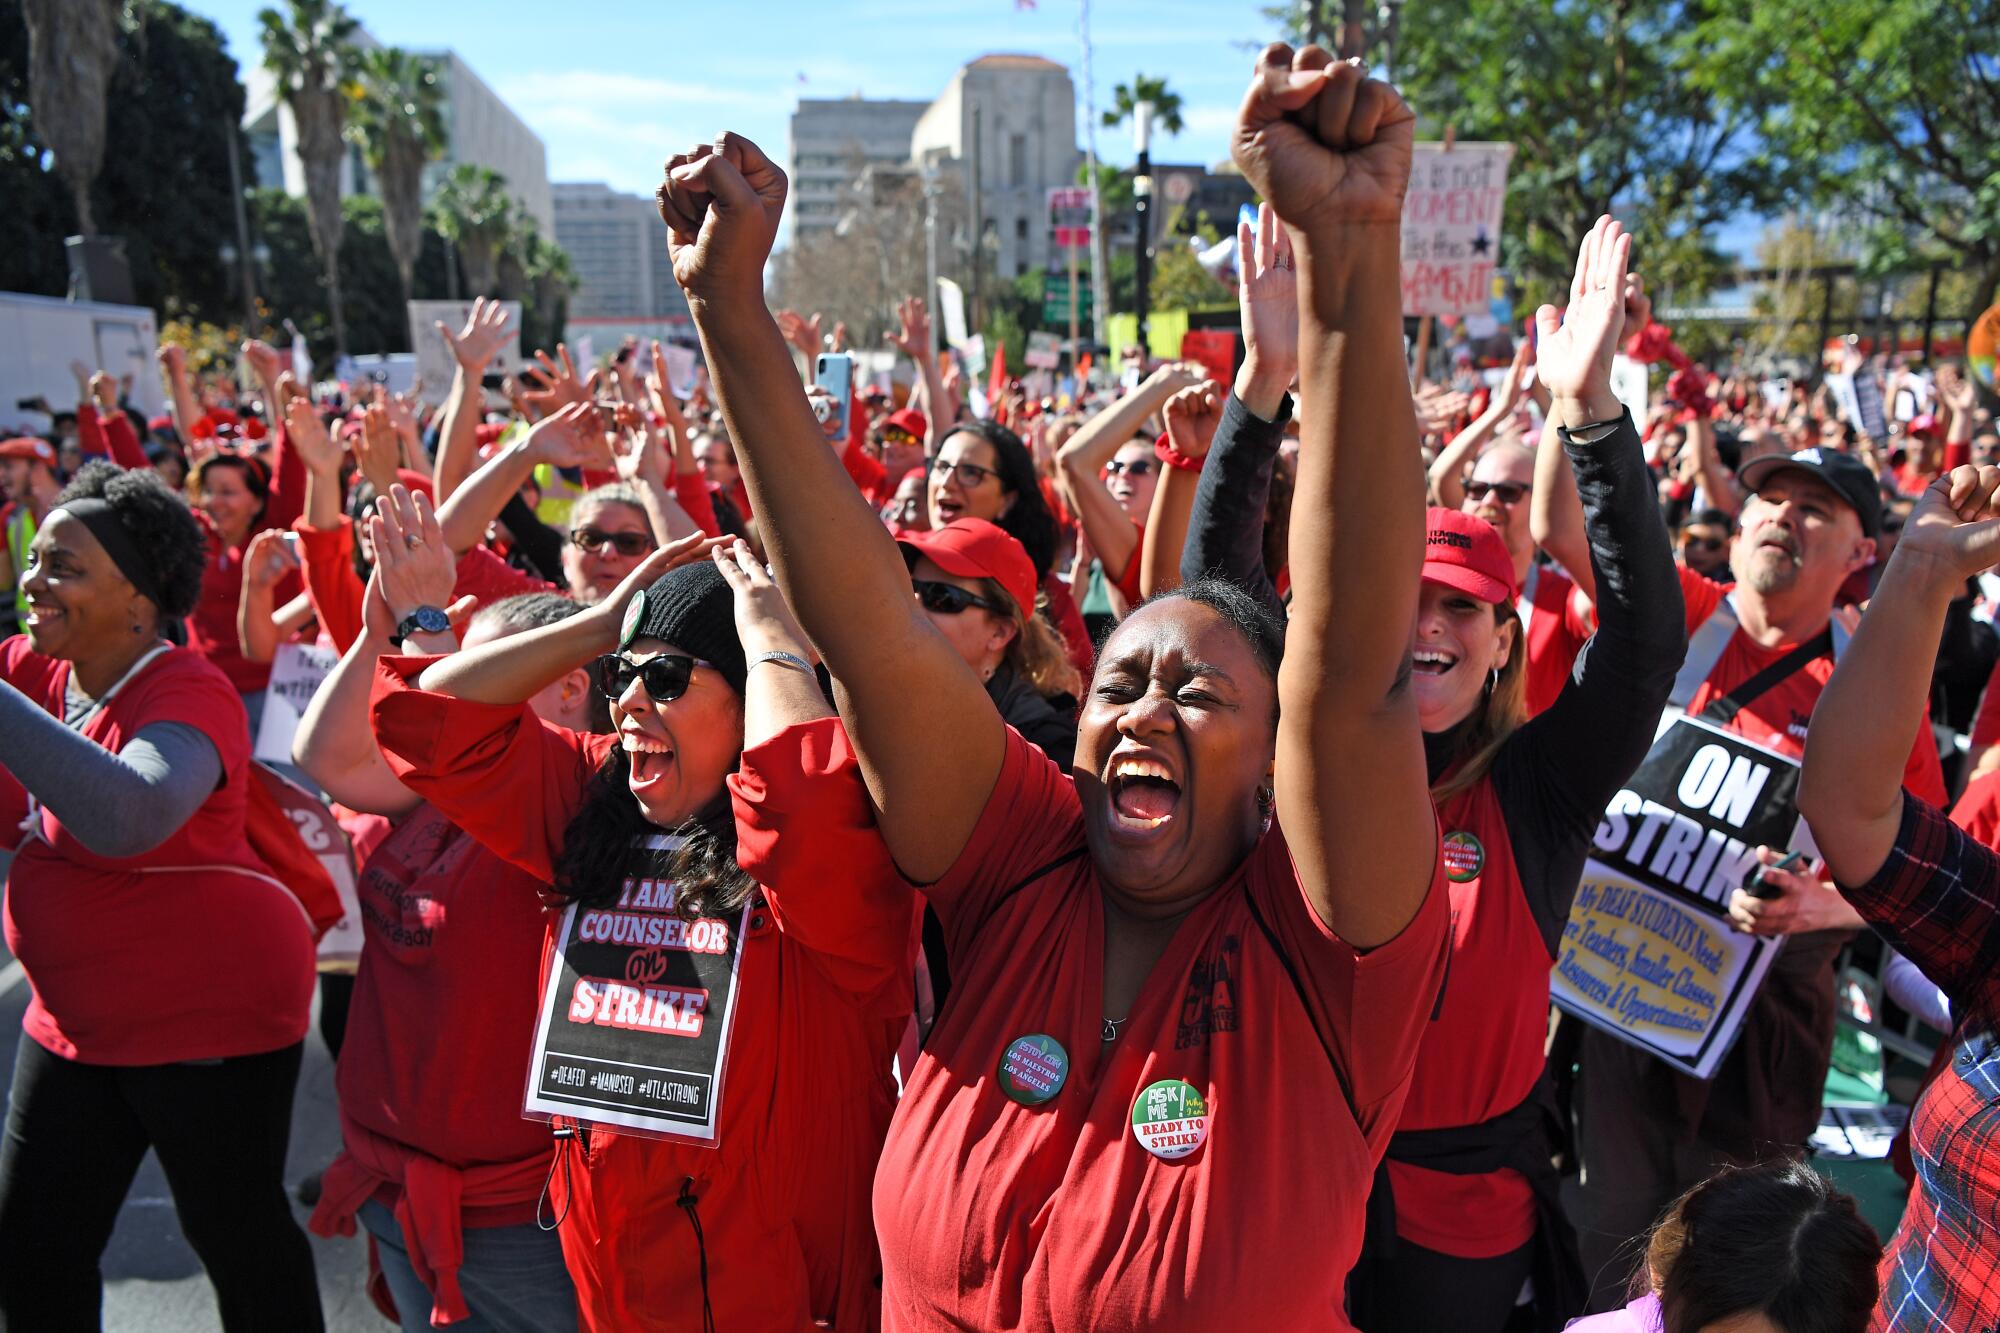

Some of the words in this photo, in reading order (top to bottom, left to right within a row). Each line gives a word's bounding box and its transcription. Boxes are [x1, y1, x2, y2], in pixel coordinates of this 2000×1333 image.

[1677, 744, 1770, 828] ON
[1593, 789, 1760, 908] STRIK
[619, 880, 634, 907] I
[633, 881, 676, 909] AM
[579, 914, 728, 952] COUNSELOR
[1595, 886, 1637, 918] DEAF
[1629, 893, 1697, 952] STUDENTS
[628, 950, 664, 980] on
[1558, 948, 1612, 1003] Resources
[1628, 941, 1675, 989] Smaller
[571, 982, 705, 1032] STRIKE
[1007, 1050, 1022, 1061] LOS
[1021, 1057, 1061, 1082] MAESTROS
[1018, 1041, 1045, 1059] ESTOY
[1043, 1054, 1063, 1069] CON
[550, 1066, 586, 1088] #DEAFED
[638, 1081, 700, 1105] #UTLASTRONG
[1003, 1063, 1018, 1075] LOS
[1017, 1072, 1051, 1092] ANGELES
[1147, 1086, 1179, 1105] ASK
[1185, 1097, 1203, 1109] Why
[1142, 1121, 1183, 1136] READY
[1187, 1119, 1204, 1130] TO
[1147, 1103, 1168, 1121] ME
[1151, 1133, 1199, 1148] STRIKE
